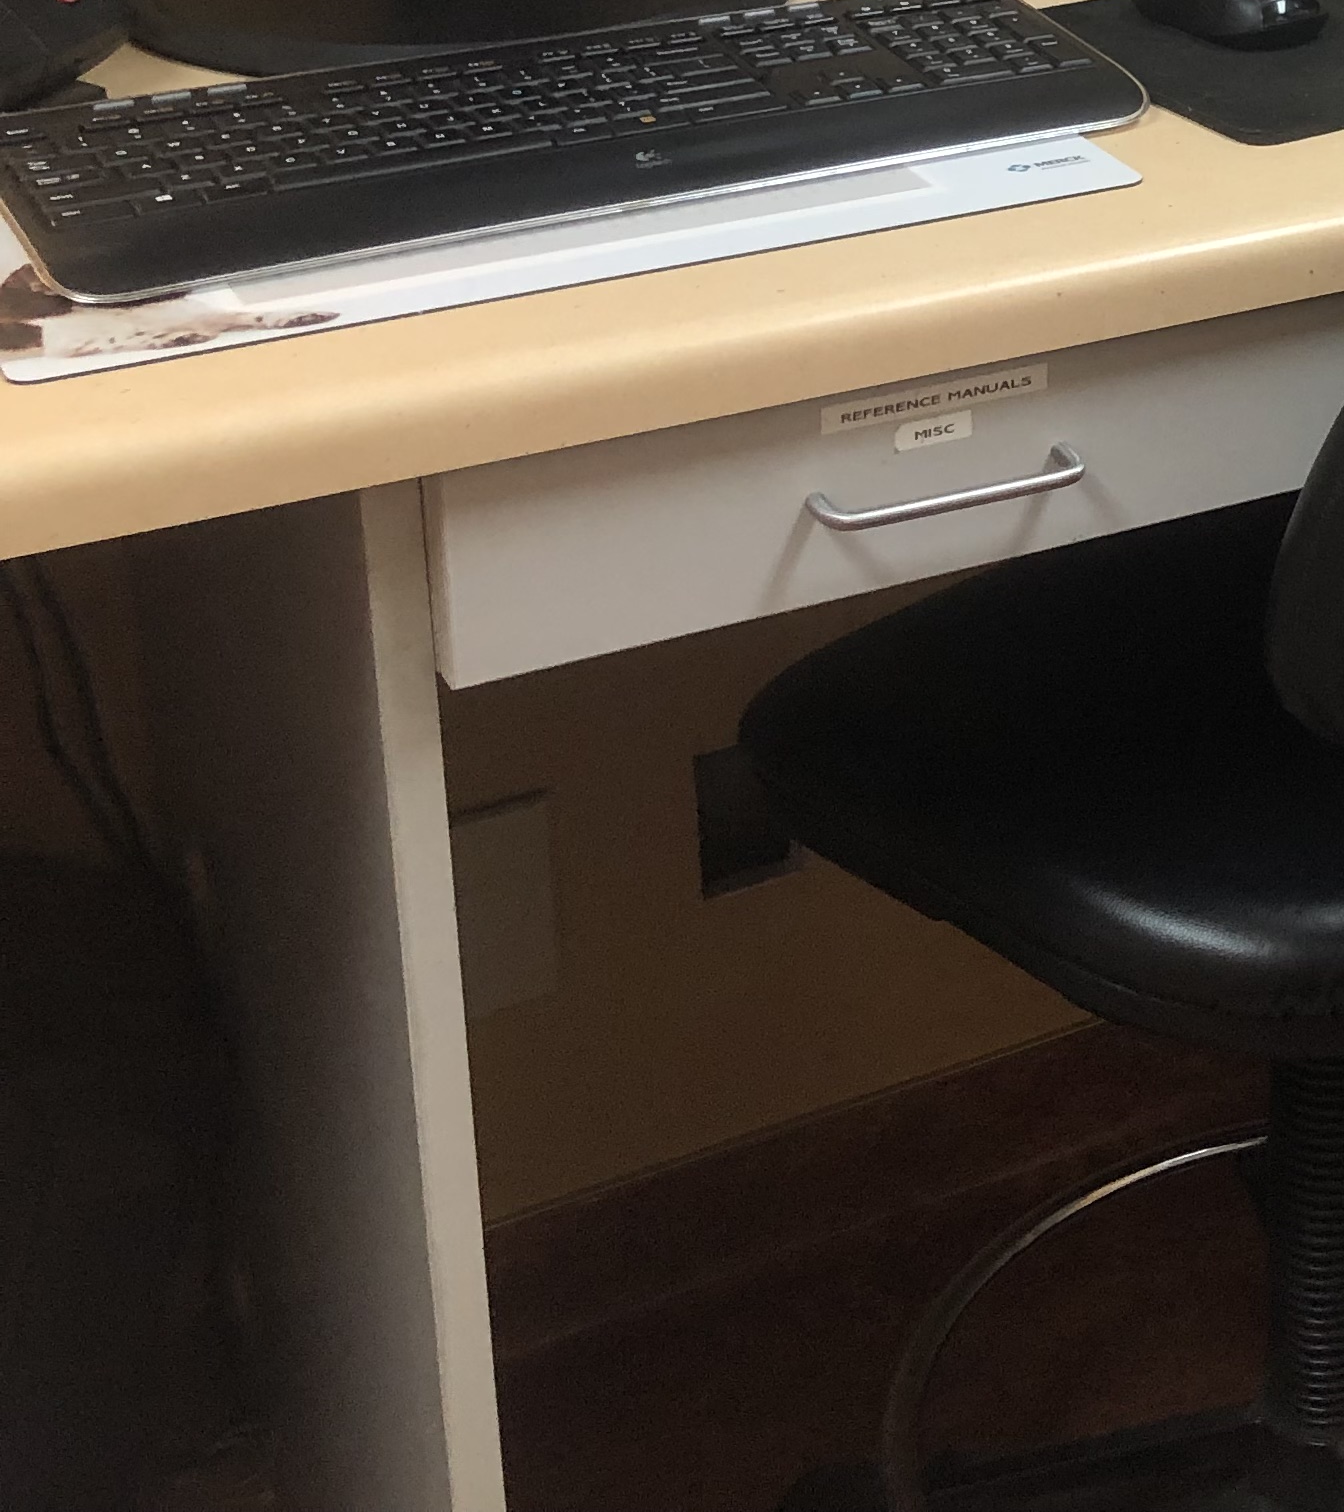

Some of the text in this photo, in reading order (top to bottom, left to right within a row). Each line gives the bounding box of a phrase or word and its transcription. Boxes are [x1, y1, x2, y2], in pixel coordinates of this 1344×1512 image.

[1034, 155, 1085, 168] MERCK
[841, 376, 1032, 424] REFERENCE MANUALS
[914, 424, 956, 440] MISC
